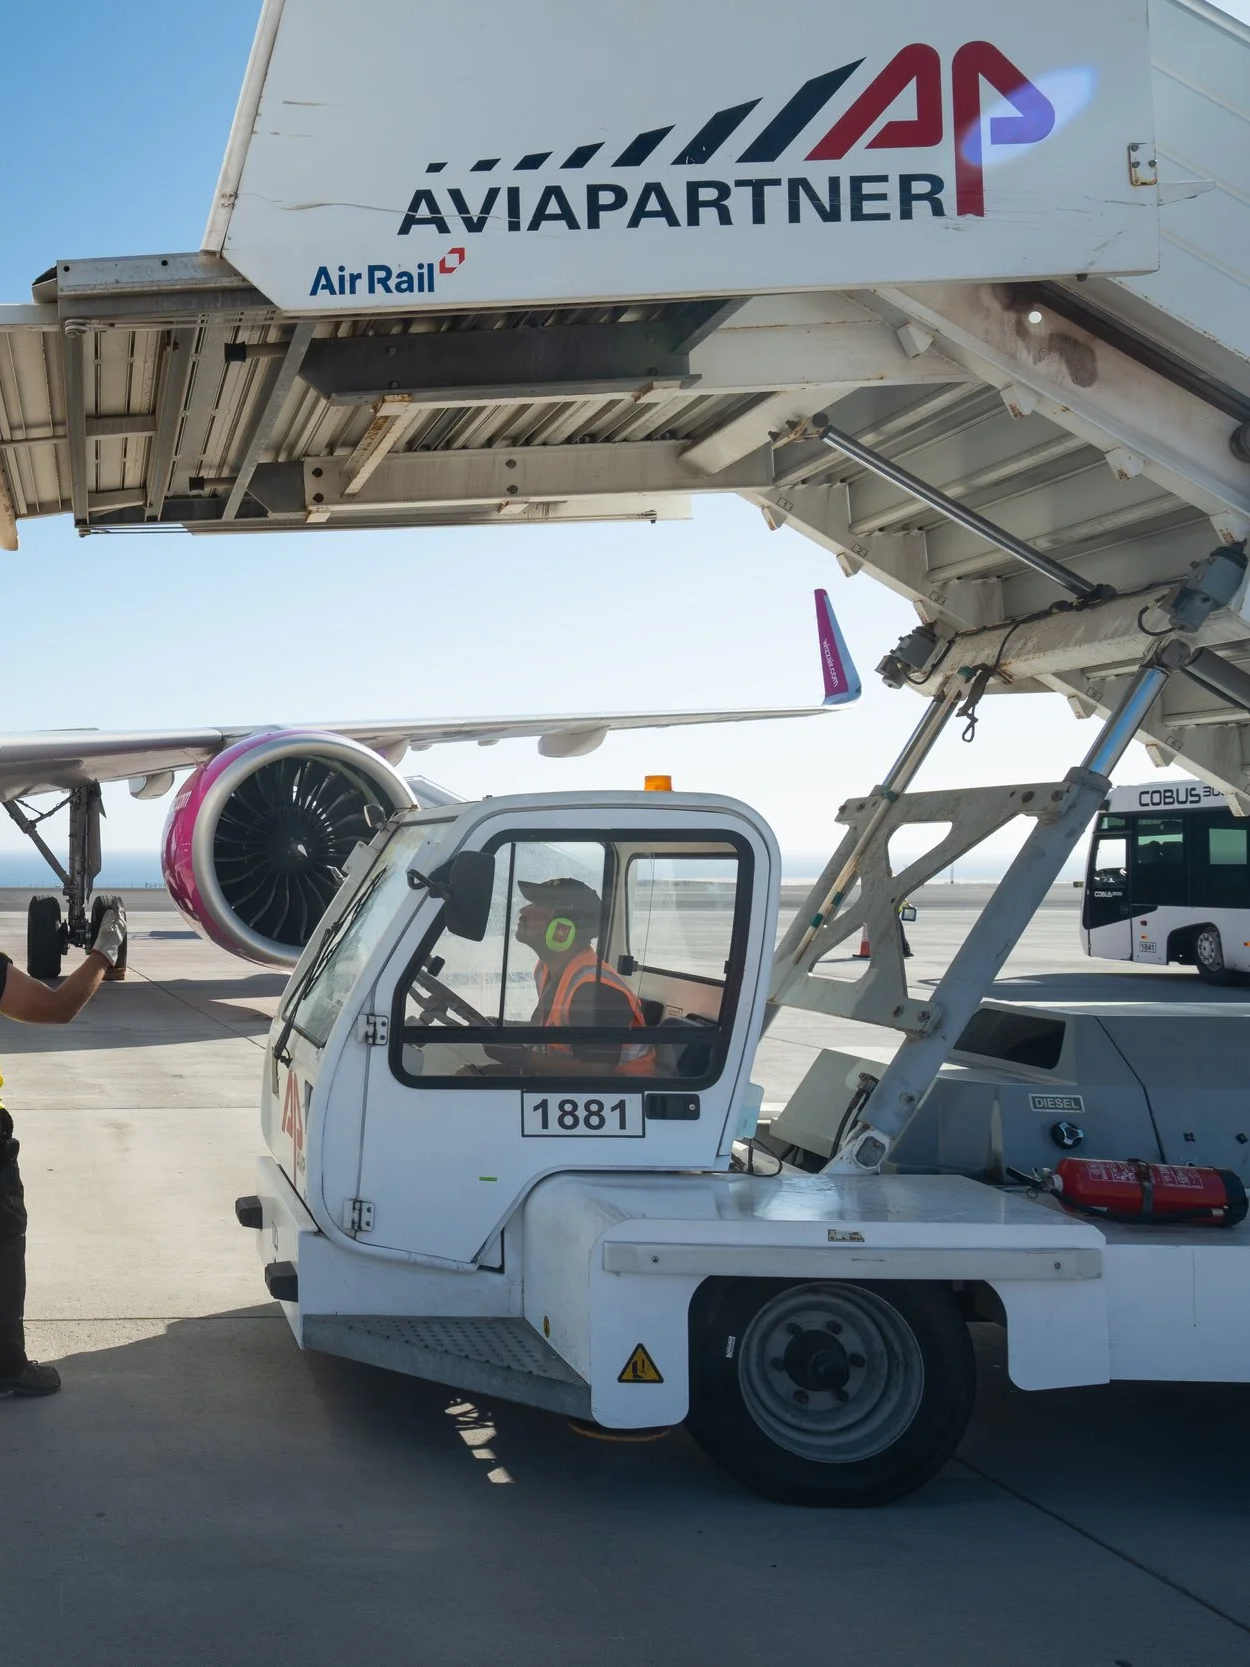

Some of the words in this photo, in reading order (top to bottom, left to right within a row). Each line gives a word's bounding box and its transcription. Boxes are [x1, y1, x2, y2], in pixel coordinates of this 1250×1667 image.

[397, 172, 945, 236] AVIAPARTNER
[822, 638, 839, 688] wizzair.com
[1139, 787, 1202, 807] COBUS
[533, 1098, 627, 1130] 1881
[1034, 1098, 1080, 1109] DIESEL
